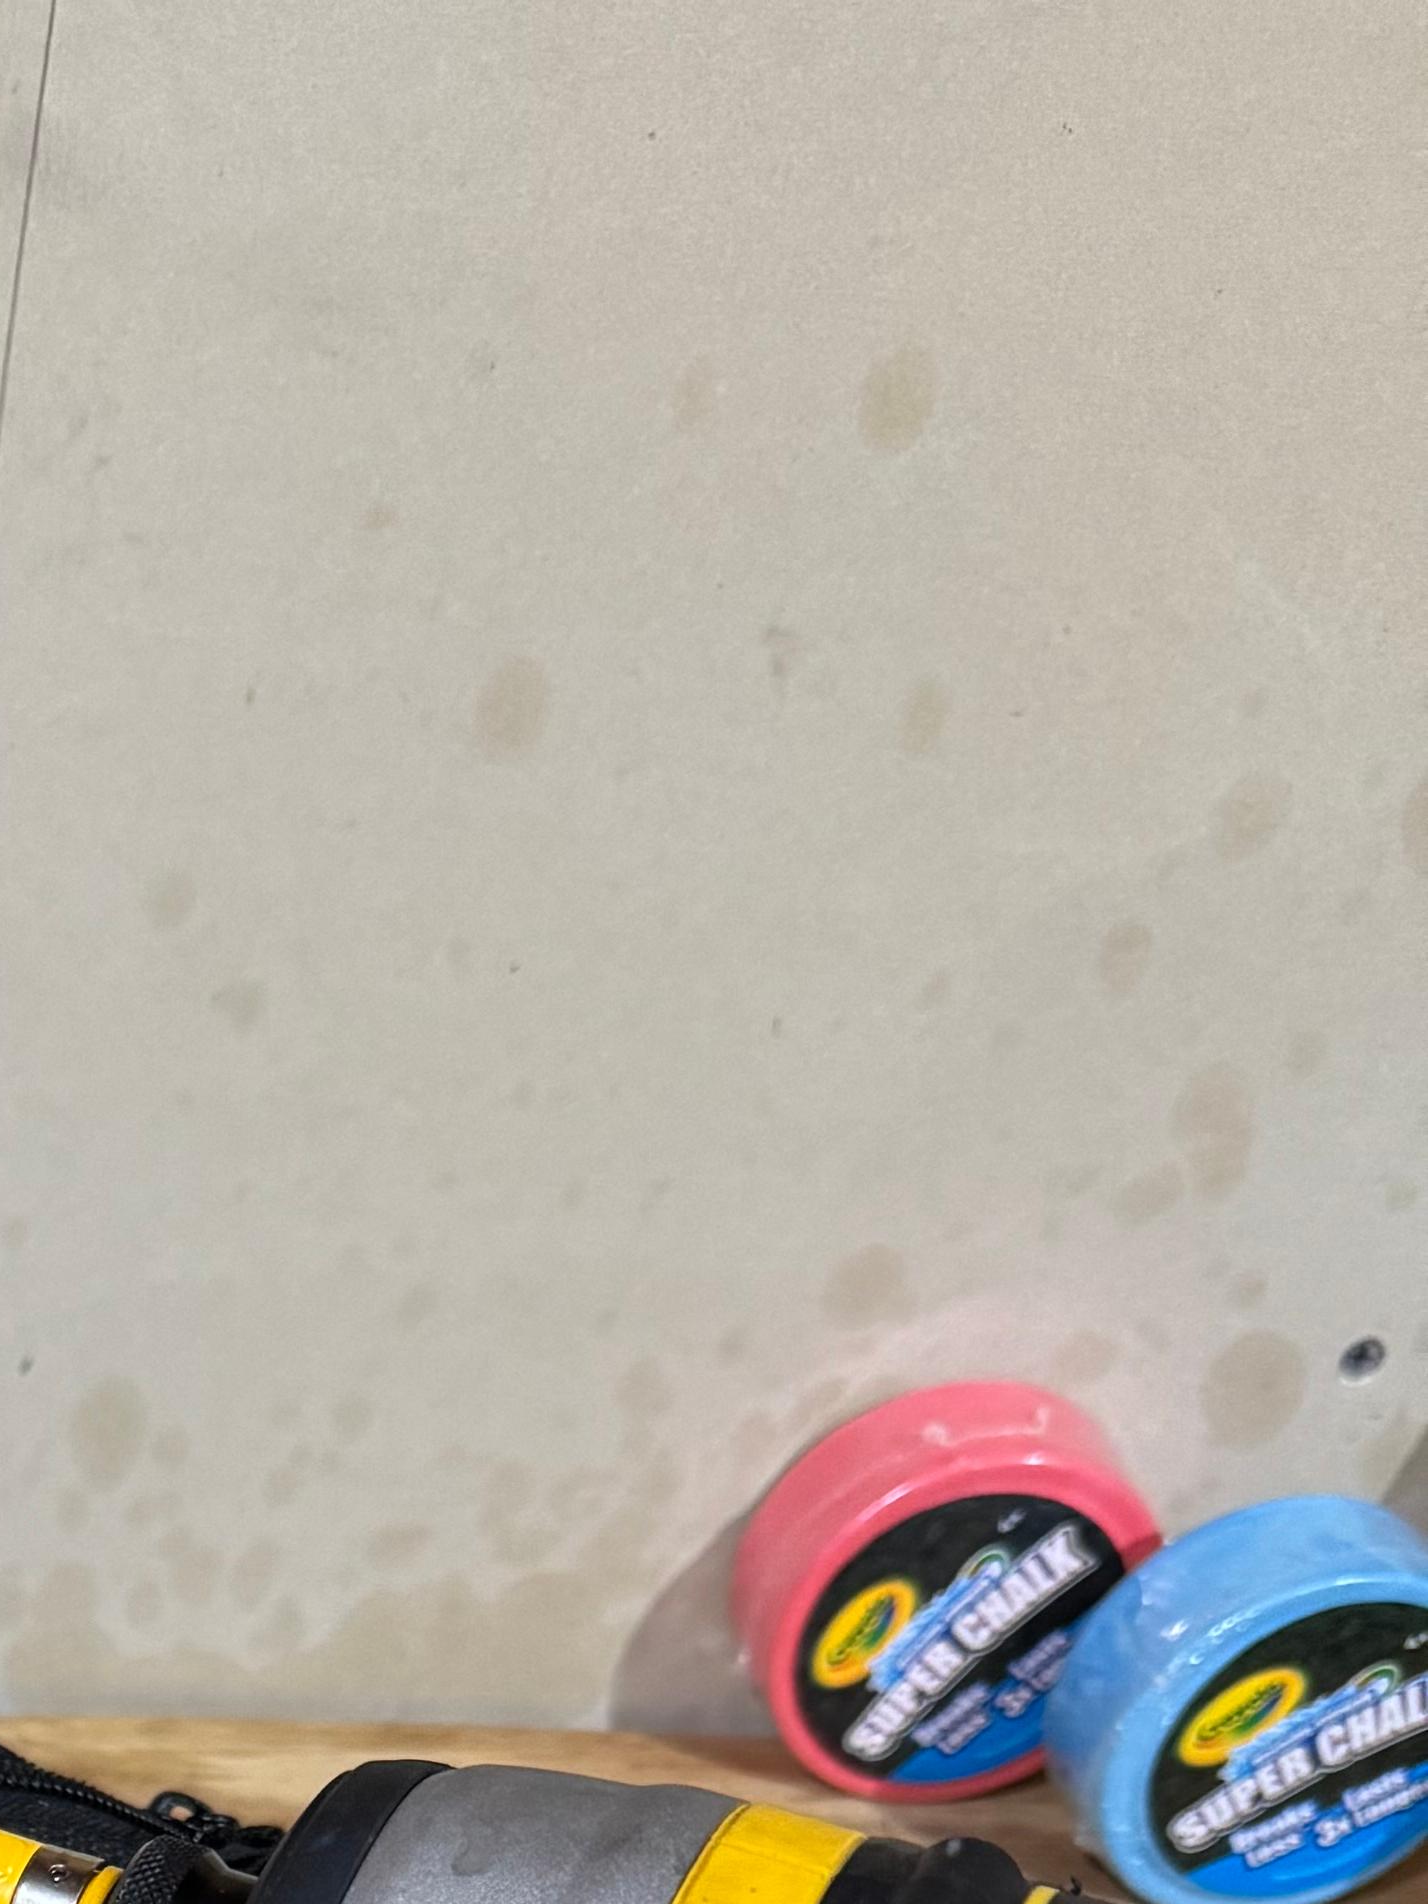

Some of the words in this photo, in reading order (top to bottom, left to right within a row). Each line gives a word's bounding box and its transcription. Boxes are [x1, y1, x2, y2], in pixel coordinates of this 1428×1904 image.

[848, 1641, 965, 1752] SUPER
[952, 1527, 1087, 1649] CHALK
[1171, 1746, 1316, 1848] SUPER
